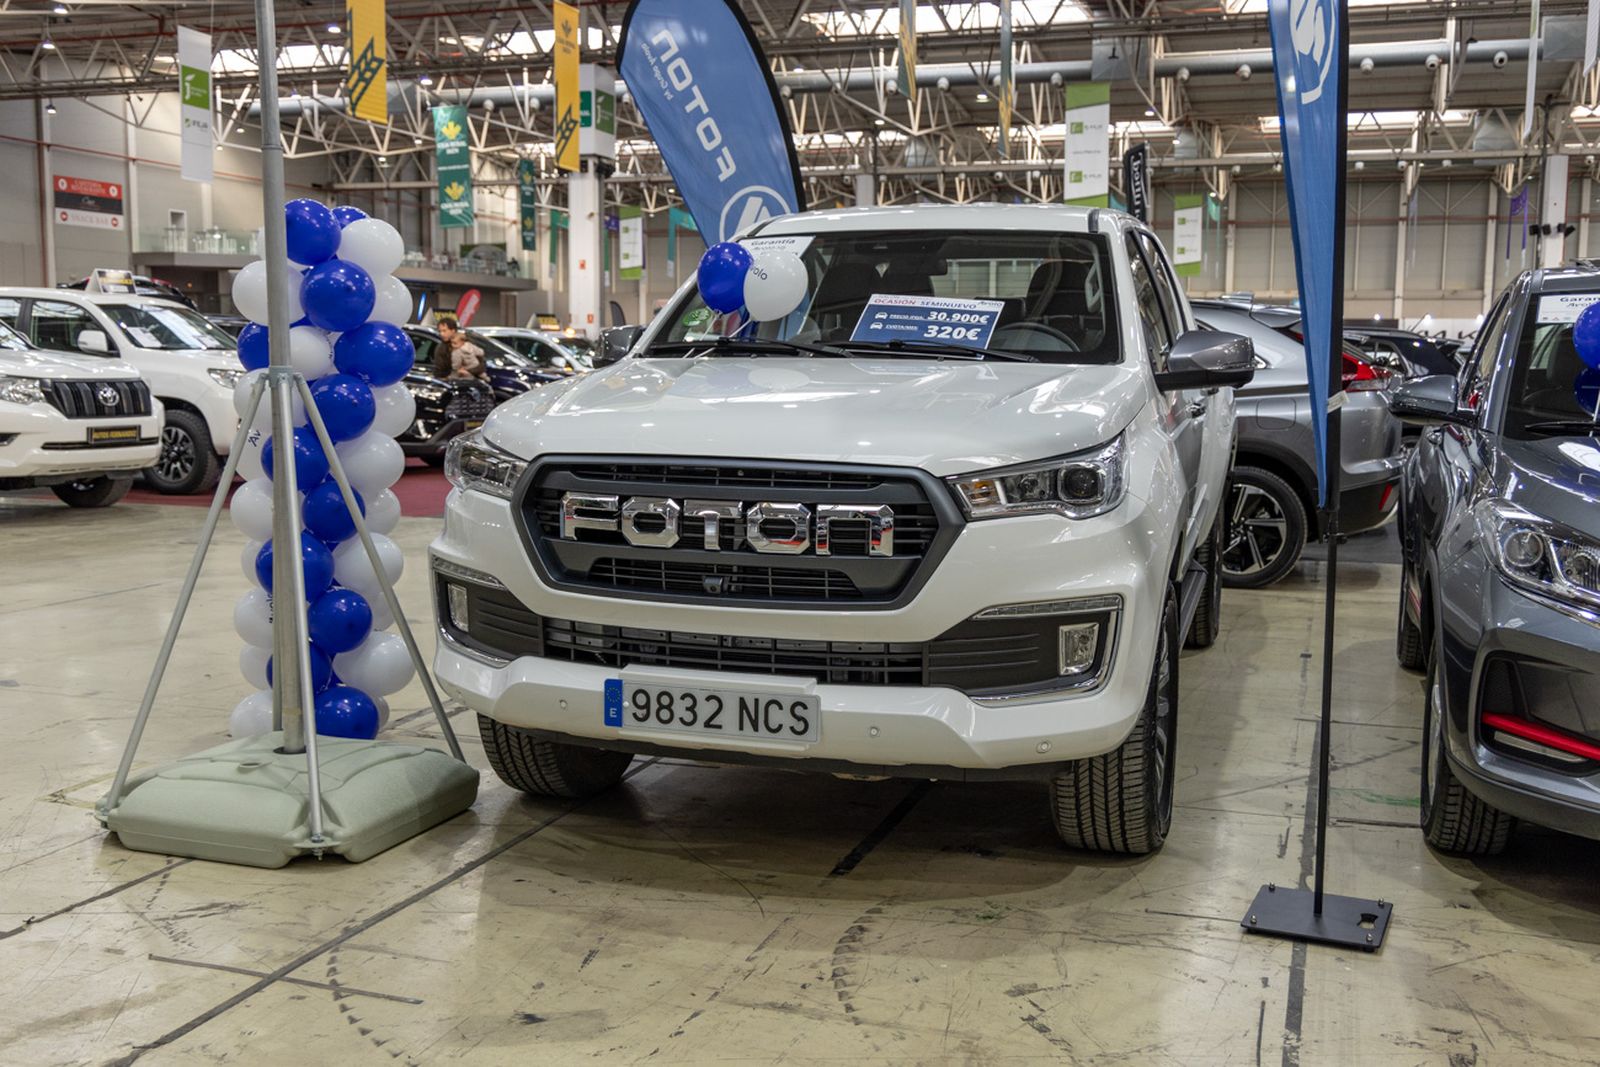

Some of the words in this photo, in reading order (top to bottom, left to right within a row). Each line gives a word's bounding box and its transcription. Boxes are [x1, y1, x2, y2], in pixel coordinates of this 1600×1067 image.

[919, 301, 977, 310] SEMINUEVO
[927, 311, 990, 324] 30.900€
[923, 325, 981, 341] 320€
[560, 491, 895, 556] FOTON
[609, 707, 618, 718] E
[631, 688, 724, 730] 9832
[738, 696, 810, 736] NCS
